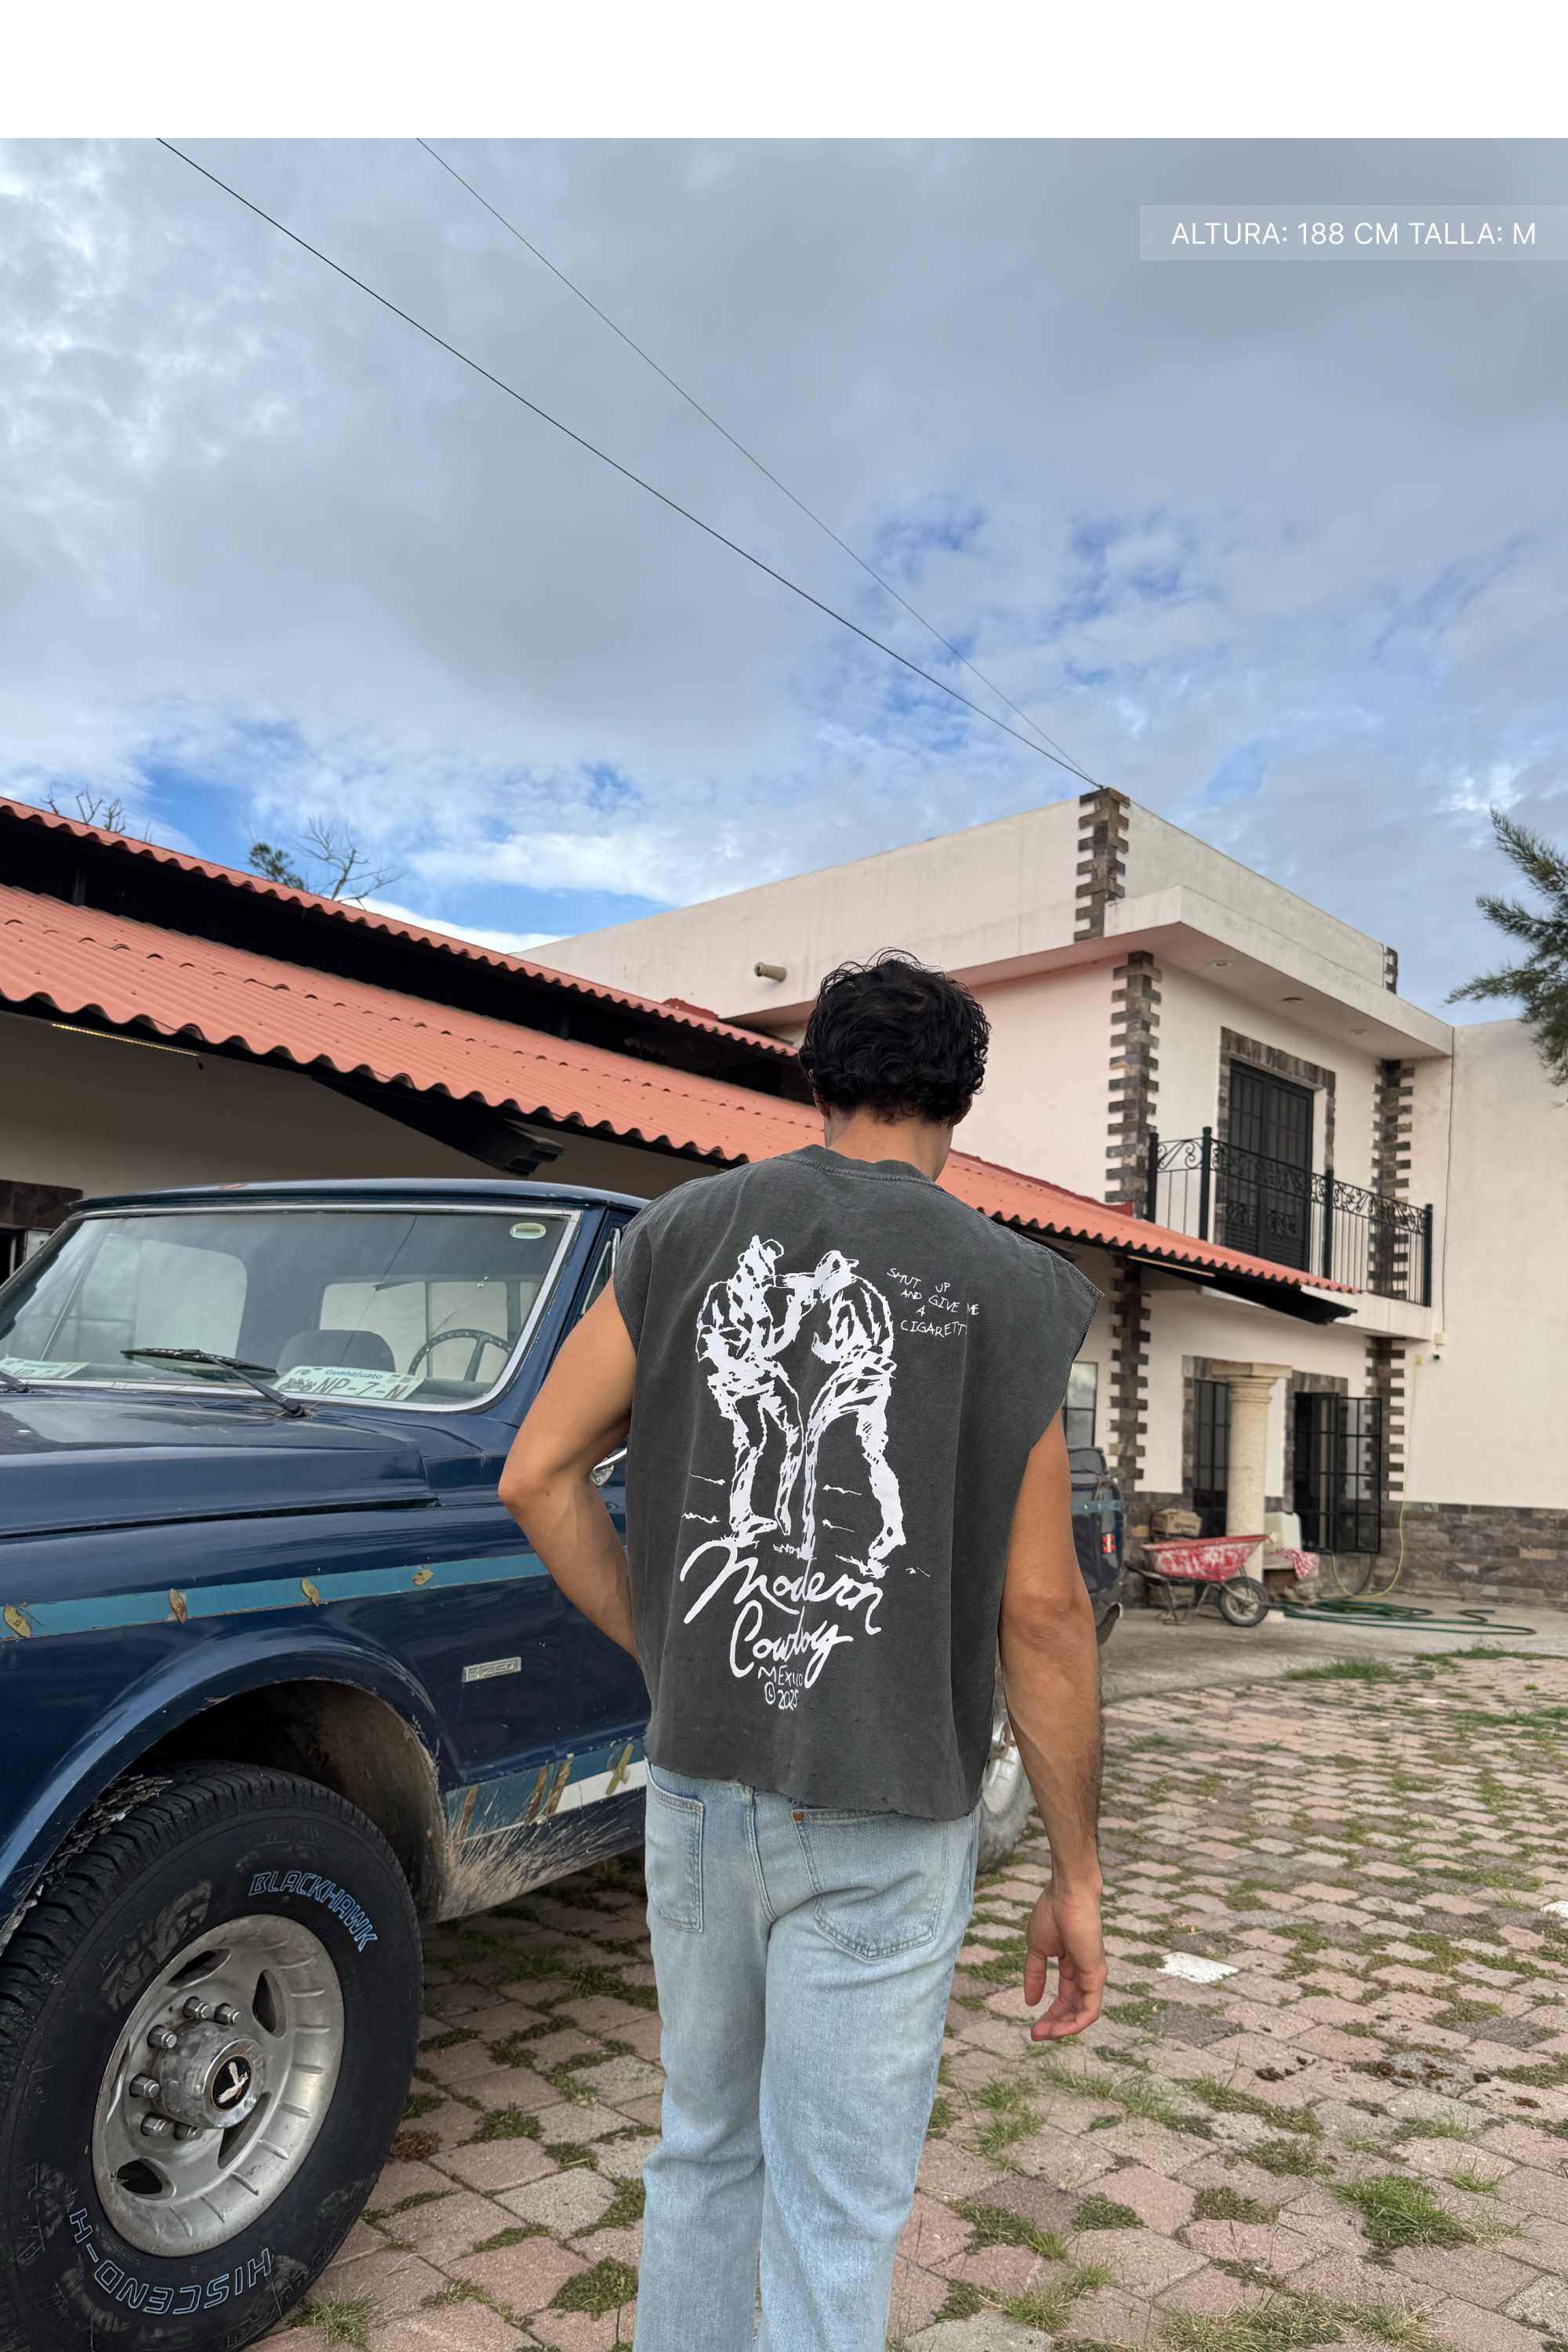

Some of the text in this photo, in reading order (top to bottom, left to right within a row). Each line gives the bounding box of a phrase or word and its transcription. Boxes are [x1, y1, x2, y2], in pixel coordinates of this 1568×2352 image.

[886, 1268, 951, 1293] SHUT UP
[901, 1289, 923, 1300] AND
[928, 1294, 960, 1313] GIVE
[915, 1305, 926, 1317] A
[901, 1320, 967, 1338] CIGARETT
[325, 1369, 383, 1380] Guanajuato
[680, 1539, 884, 1635] Modern
[777, 1689, 800, 1711] 2025
[248, 1870, 378, 1952] BLACKHAWK
[69, 2208, 272, 2314] HISCEND-H
